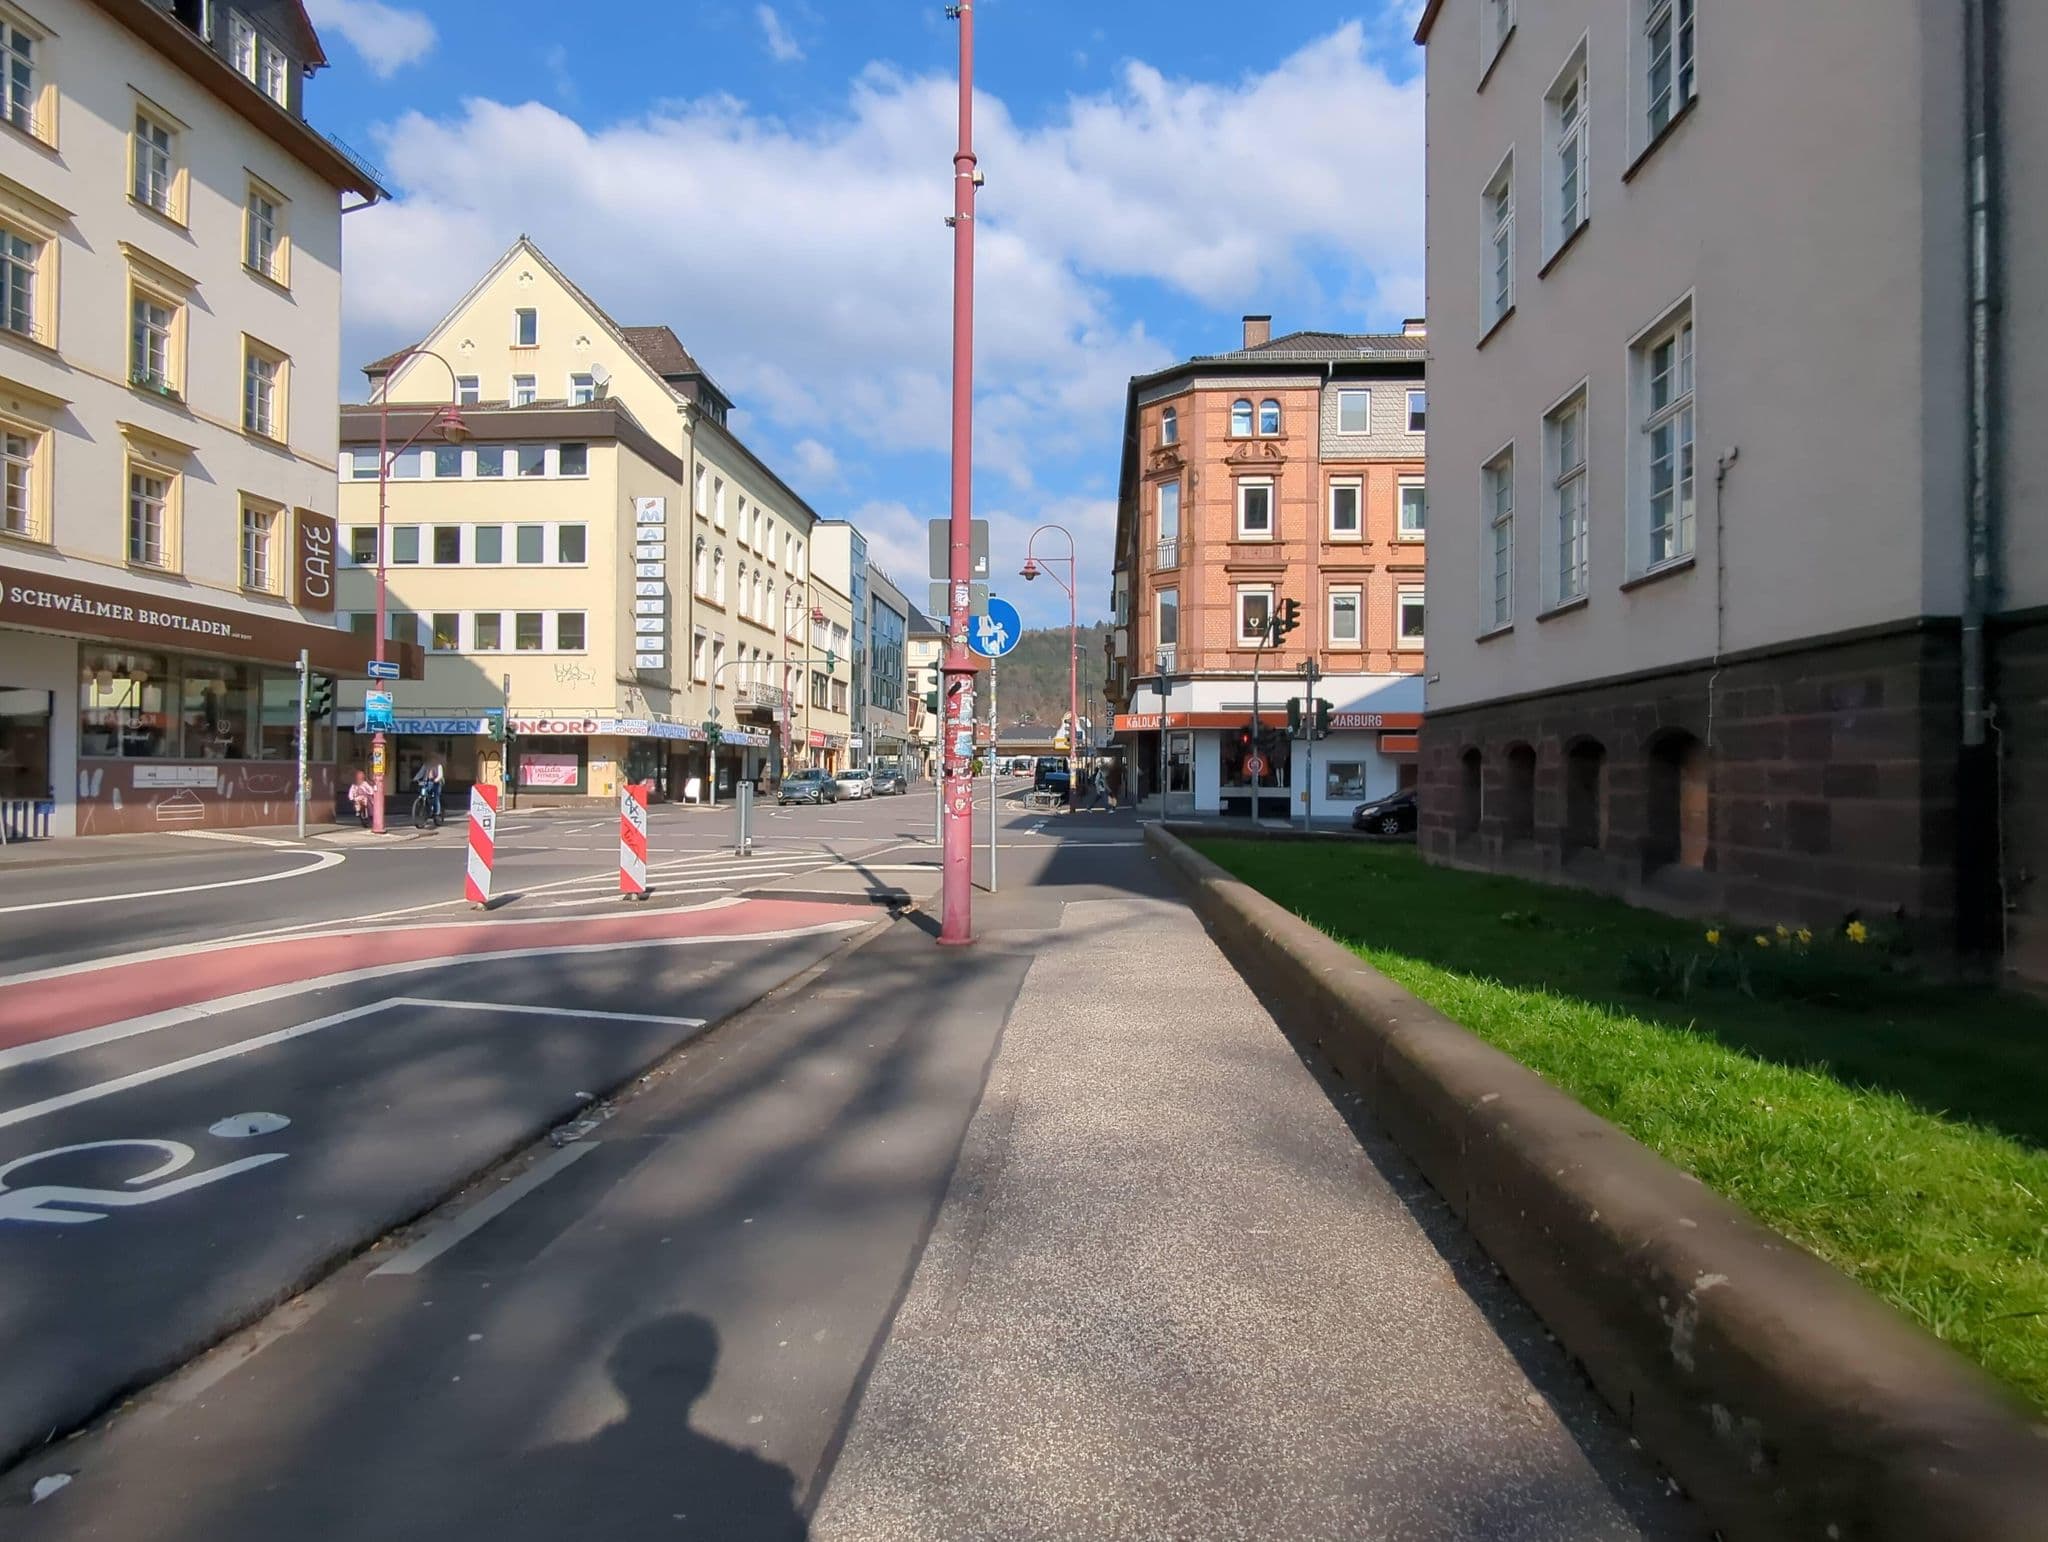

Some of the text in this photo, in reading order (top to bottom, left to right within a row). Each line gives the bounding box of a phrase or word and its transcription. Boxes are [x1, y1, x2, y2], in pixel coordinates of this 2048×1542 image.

[639, 510, 660, 667] MATRATZEN
[10, 586, 231, 637] SCHWÄLMER BROTLADEN
[392, 720, 480, 733] ATRATZEN
[507, 720, 598, 734] ONCORD
[1330, 714, 1383, 728] MARBURG
